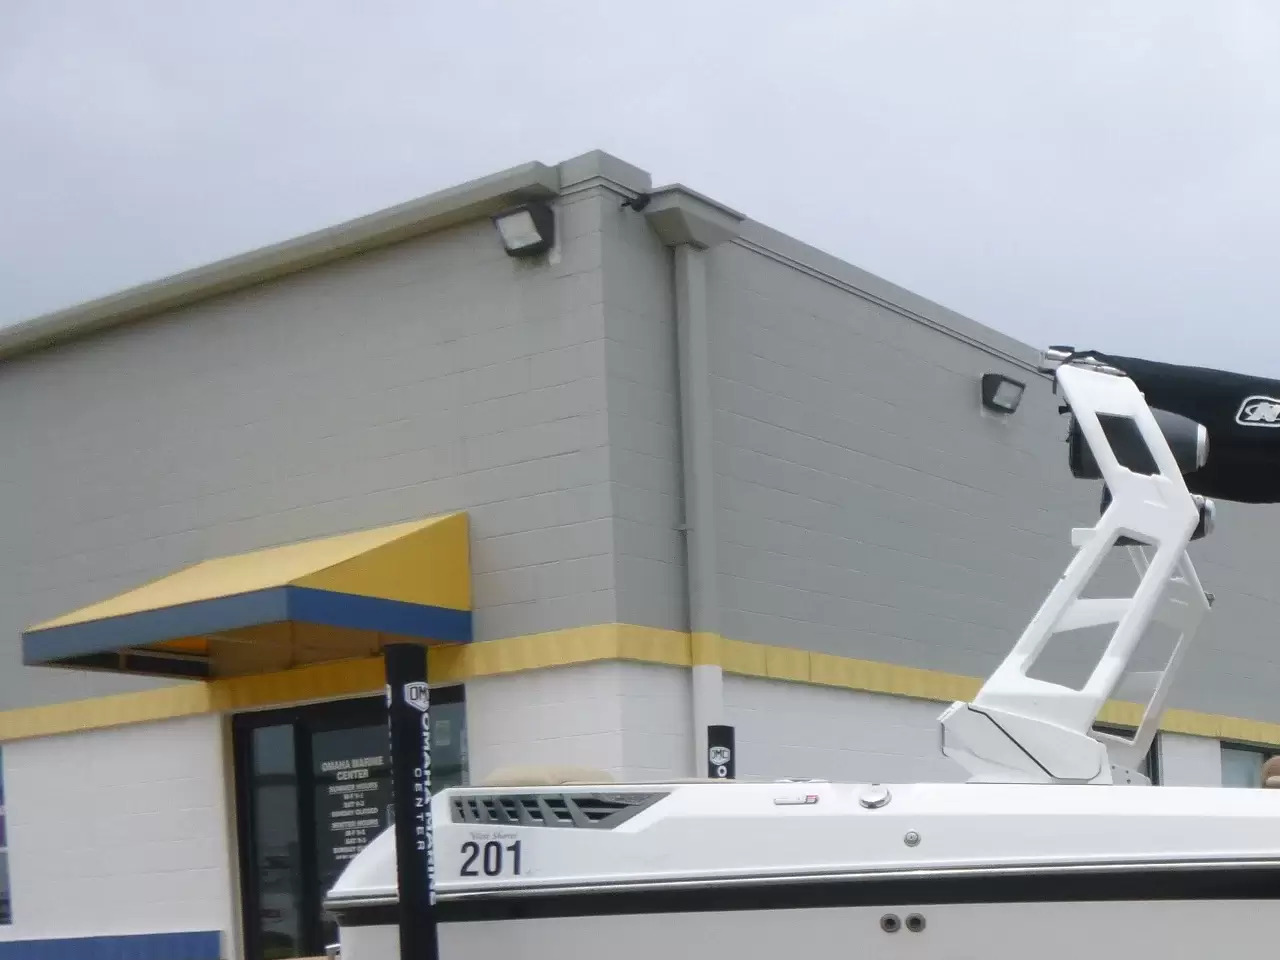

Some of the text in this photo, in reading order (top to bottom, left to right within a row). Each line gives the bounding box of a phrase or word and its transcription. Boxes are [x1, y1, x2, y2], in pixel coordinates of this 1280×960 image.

[336, 768, 369, 781] CENTER
[414, 767, 425, 850] CENTER
[460, 840, 522, 877] 201
